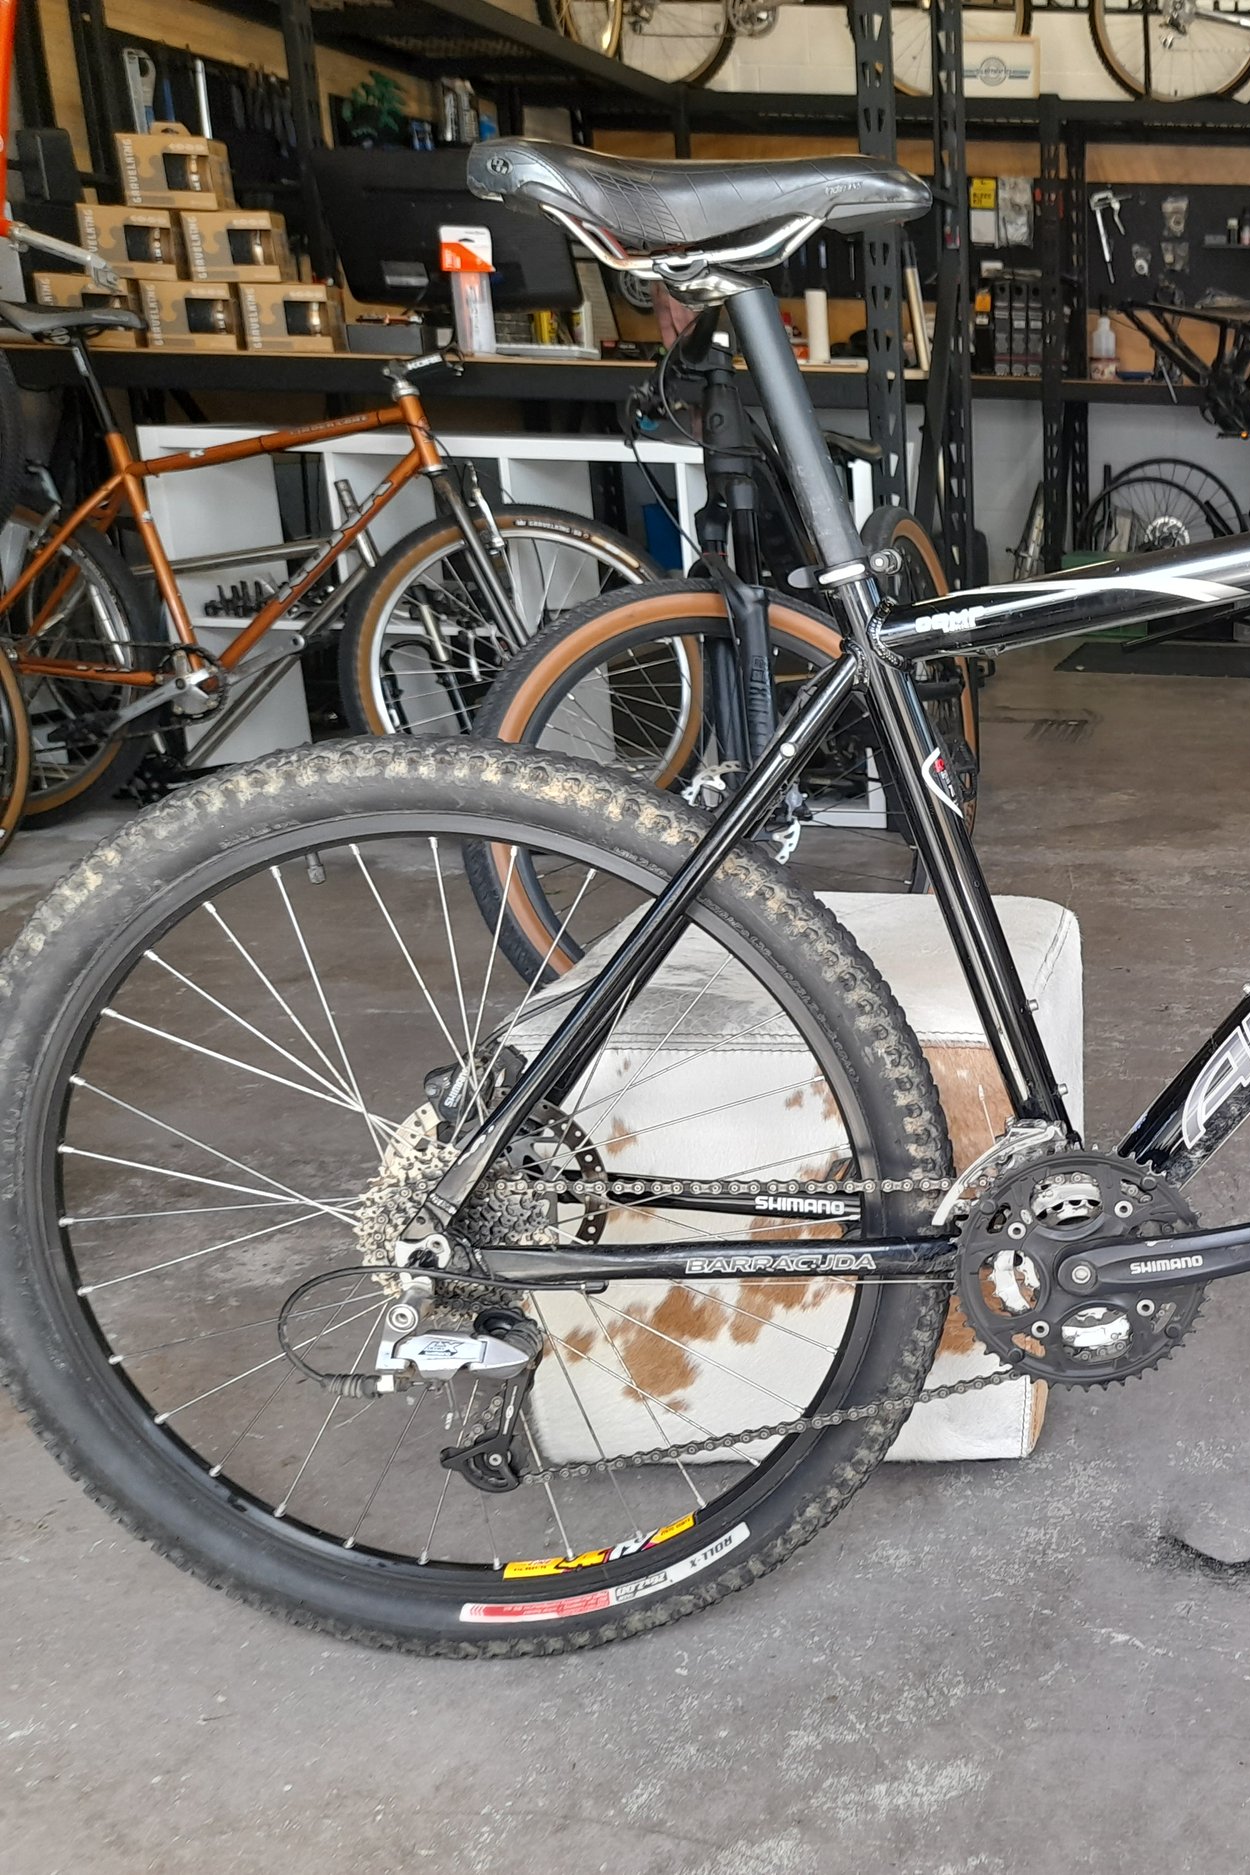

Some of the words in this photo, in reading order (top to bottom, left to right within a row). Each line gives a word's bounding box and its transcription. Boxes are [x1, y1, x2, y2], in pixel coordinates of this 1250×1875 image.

[755, 1196, 845, 1216] SHIMANO
[685, 1253, 877, 1274] BARRACUDA
[1130, 1255, 1203, 1275] SHIMANO
[690, 1533, 733, 1569] ROLL-X
